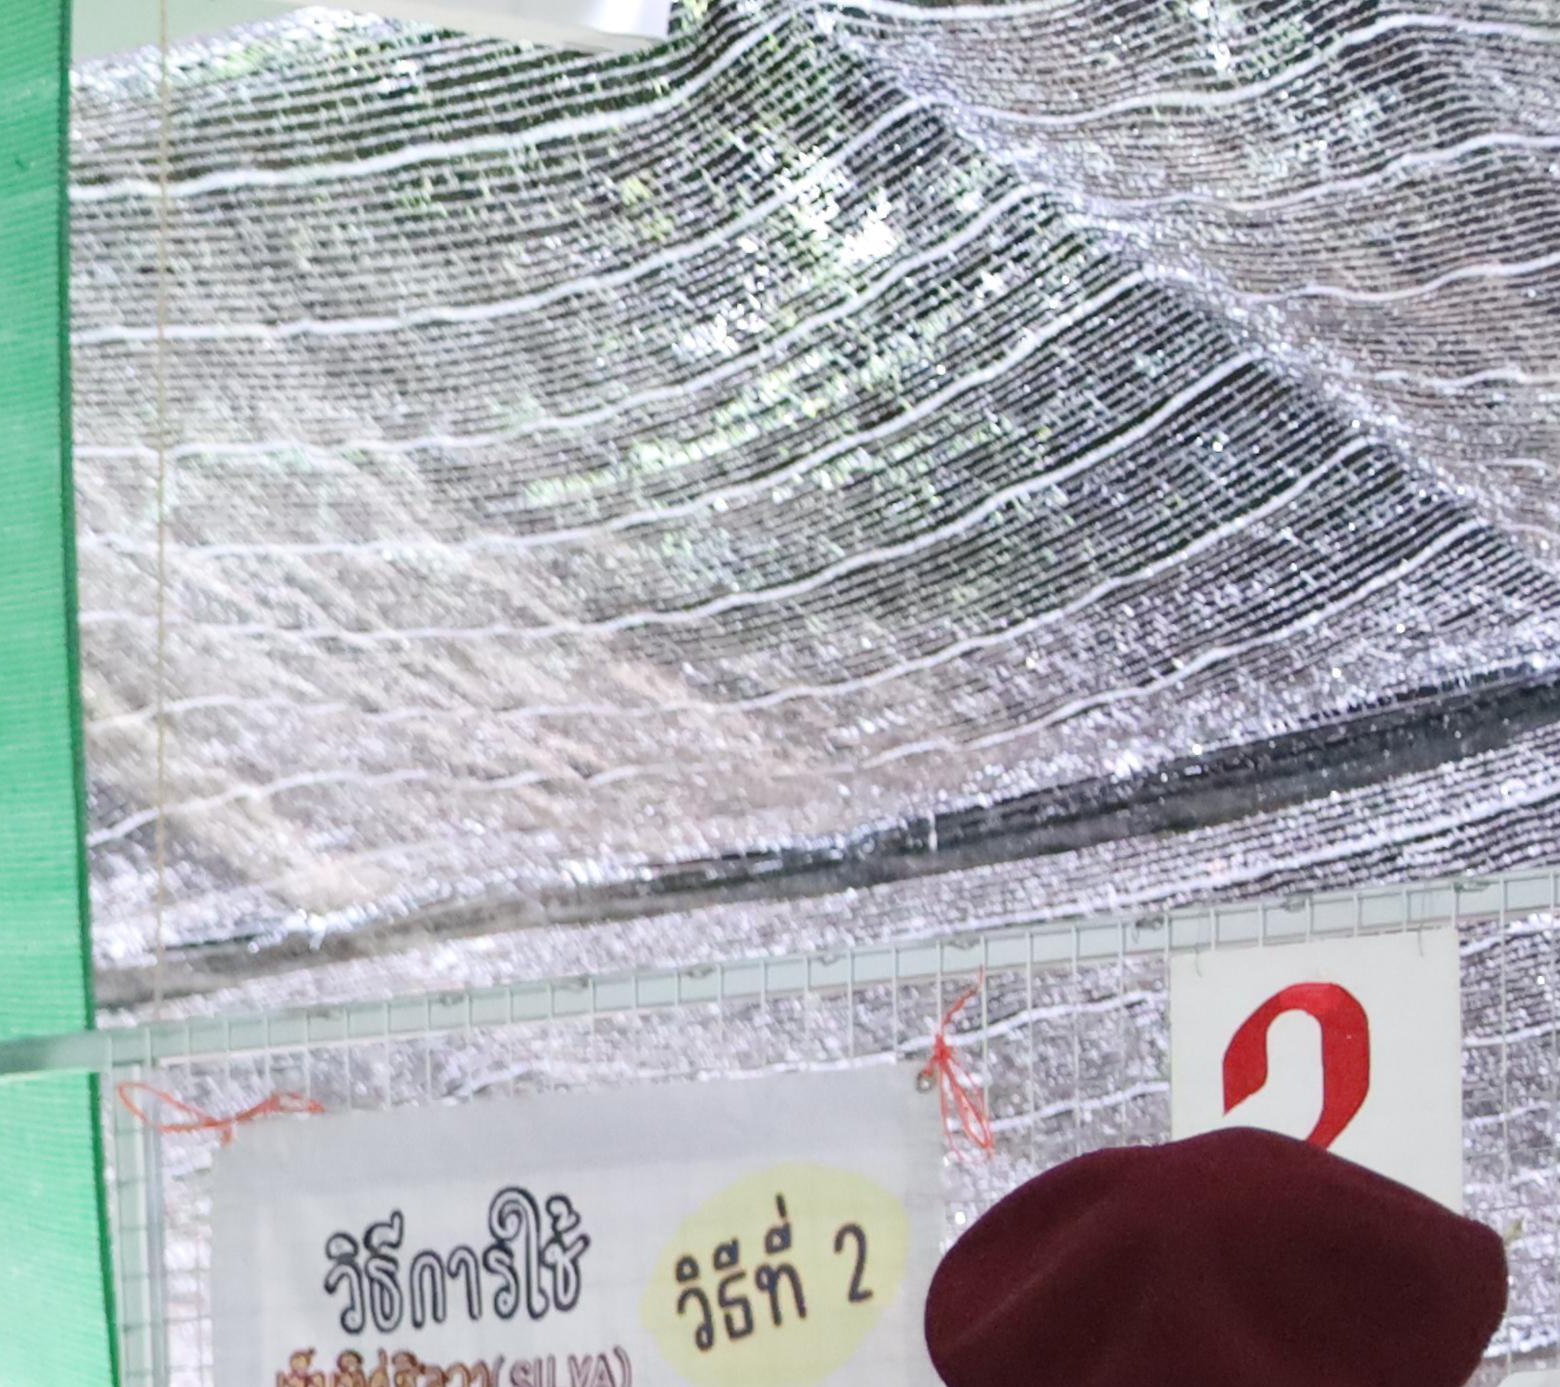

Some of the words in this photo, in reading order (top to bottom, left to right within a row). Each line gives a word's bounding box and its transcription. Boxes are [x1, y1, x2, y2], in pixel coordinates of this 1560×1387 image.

[324, 1186, 590, 1335] วิธีการใช้
[676, 1194, 807, 1353] วิธีที่
[834, 1223, 873, 1303] 2
